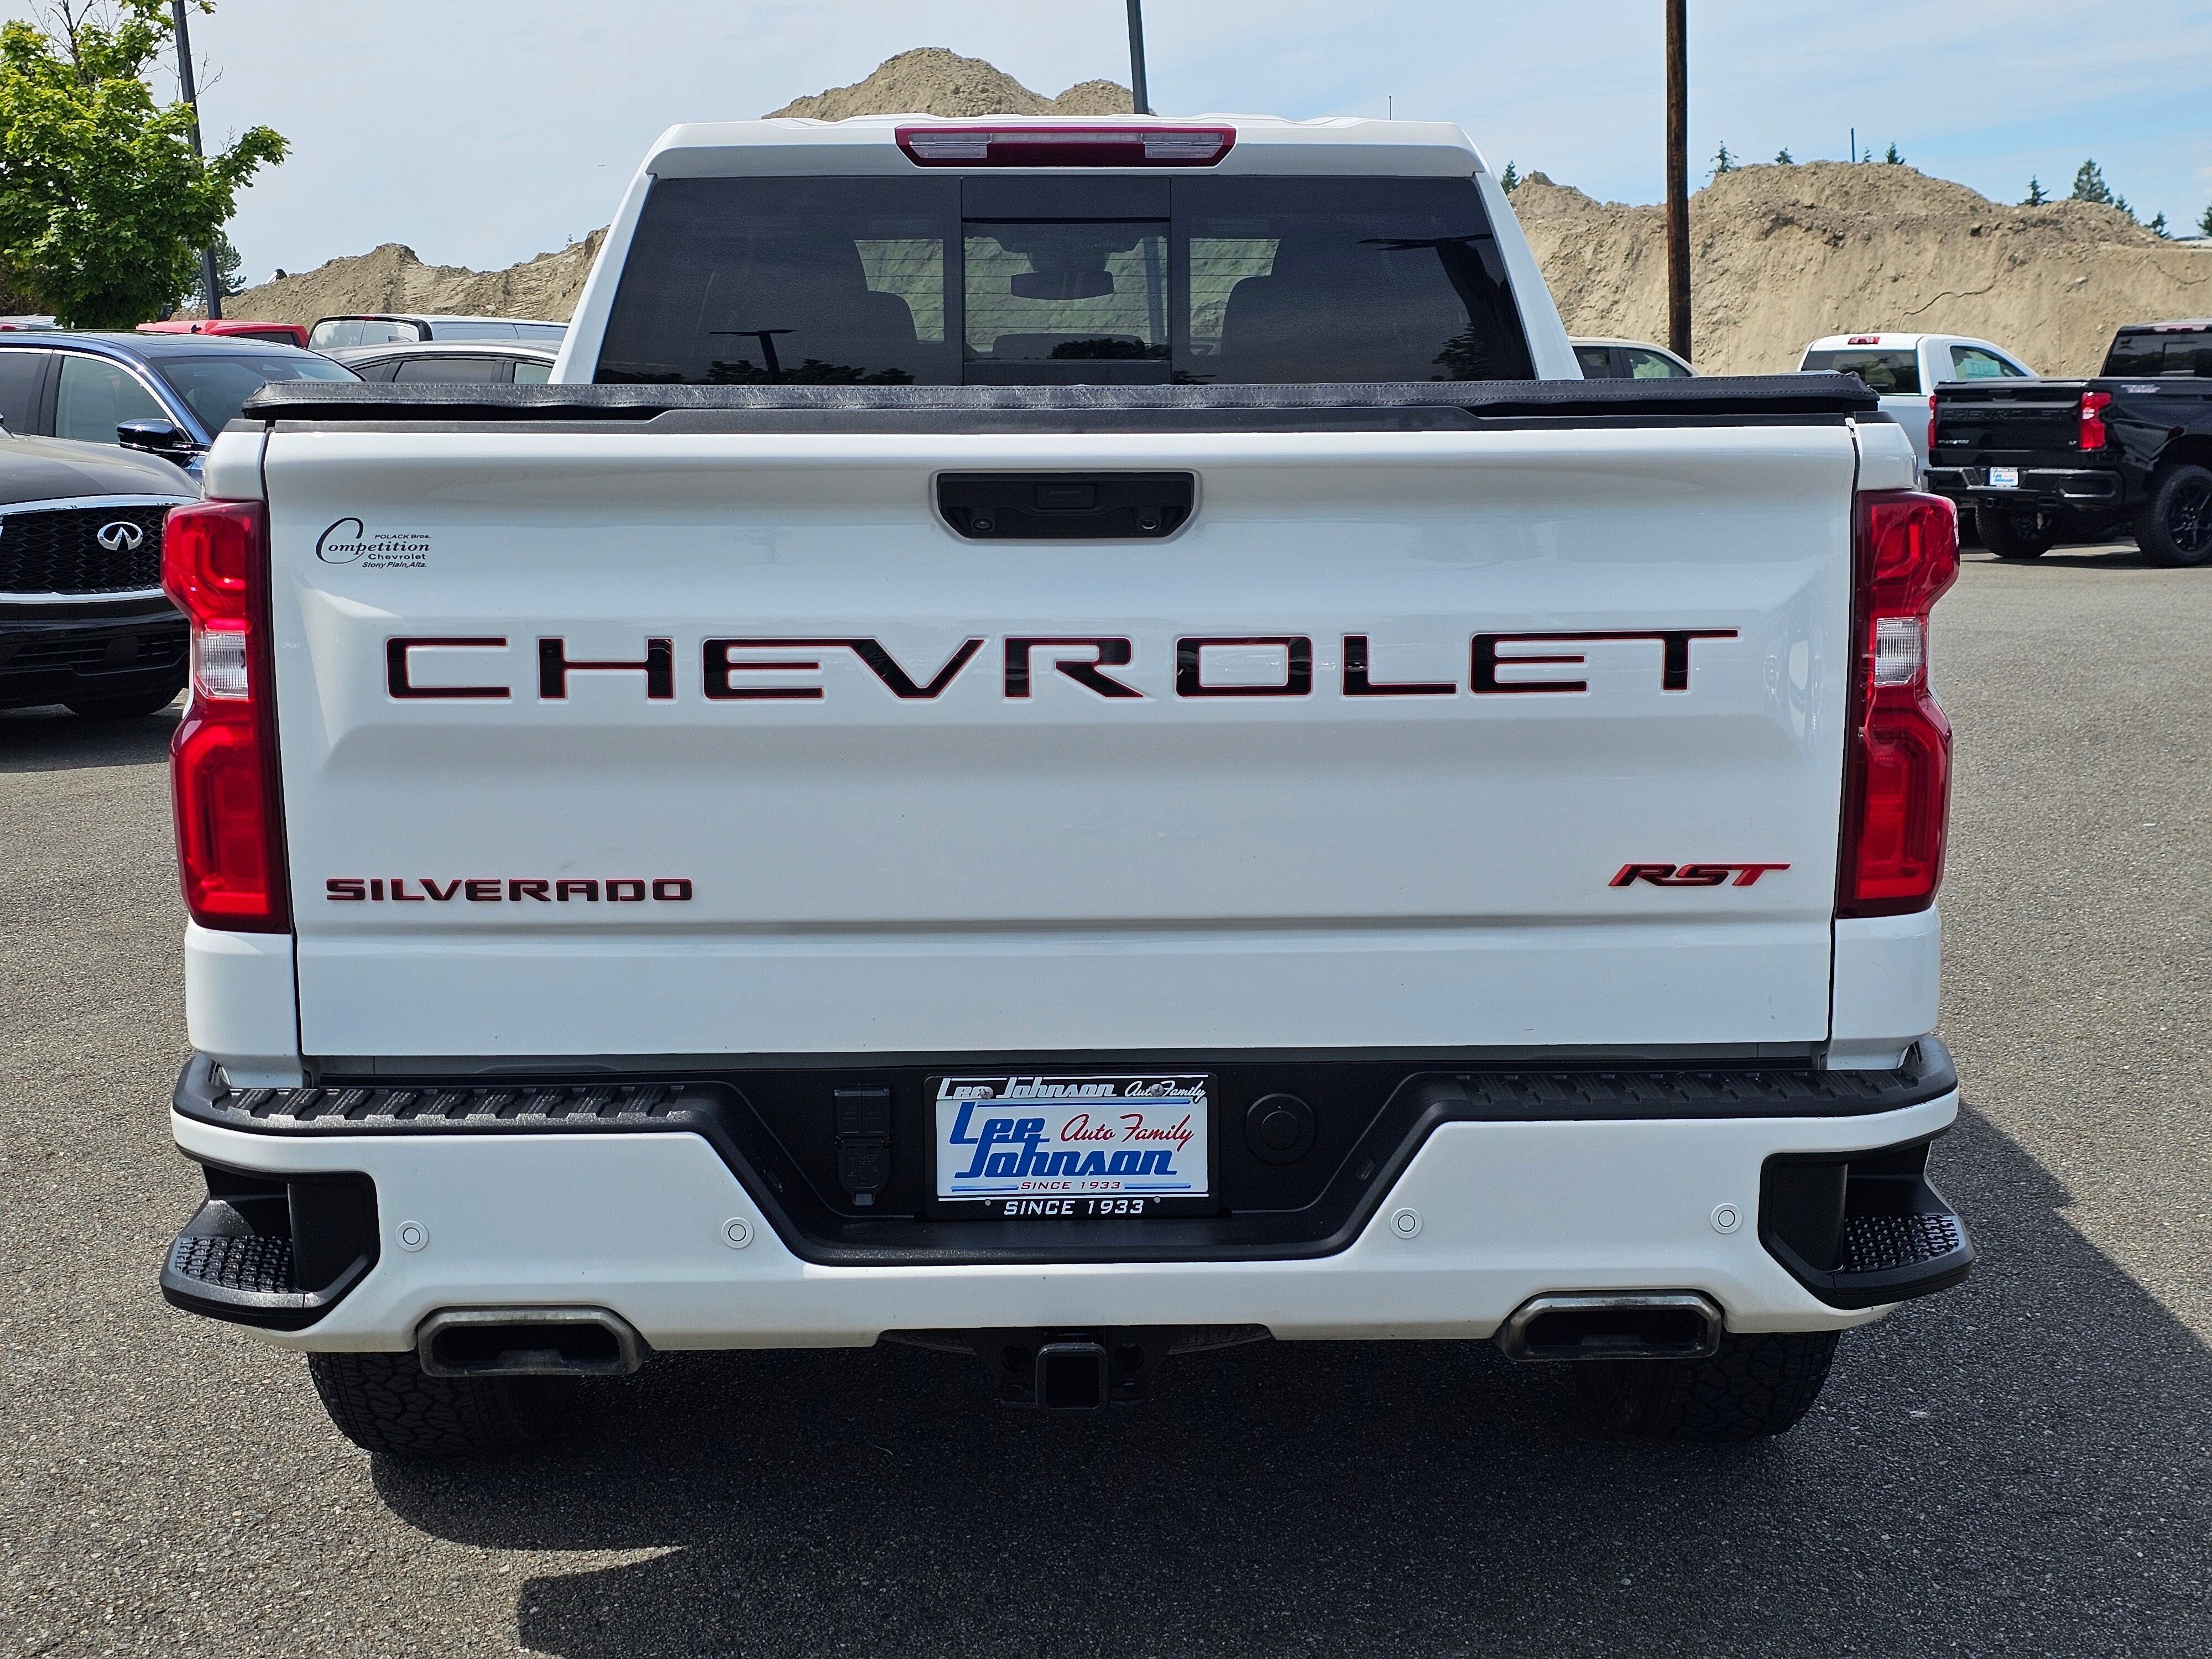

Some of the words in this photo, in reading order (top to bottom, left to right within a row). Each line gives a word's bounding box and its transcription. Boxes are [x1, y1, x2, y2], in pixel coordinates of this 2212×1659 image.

[315, 517, 430, 564] Competition
[386, 629, 1739, 699] CHEVROLET
[1608, 863, 1791, 886] RST
[326, 878, 693, 902] SILVERADO
[996, 1077, 1117, 1099] Johnson
[1124, 1081, 1159, 1097] Aut
[1160, 1080, 1206, 1103] Family
[949, 1102, 1050, 1145] Lee
[1060, 1113, 1117, 1142] Auto
[1119, 1113, 1195, 1152] Family
[954, 1136, 1178, 1178] Johnson
[1020, 1181, 1076, 1190] SINCE
[1080, 1181, 1121, 1190] 1933
[1004, 1201, 1075, 1215] SINCE
[1087, 1199, 1144, 1215] 1933
